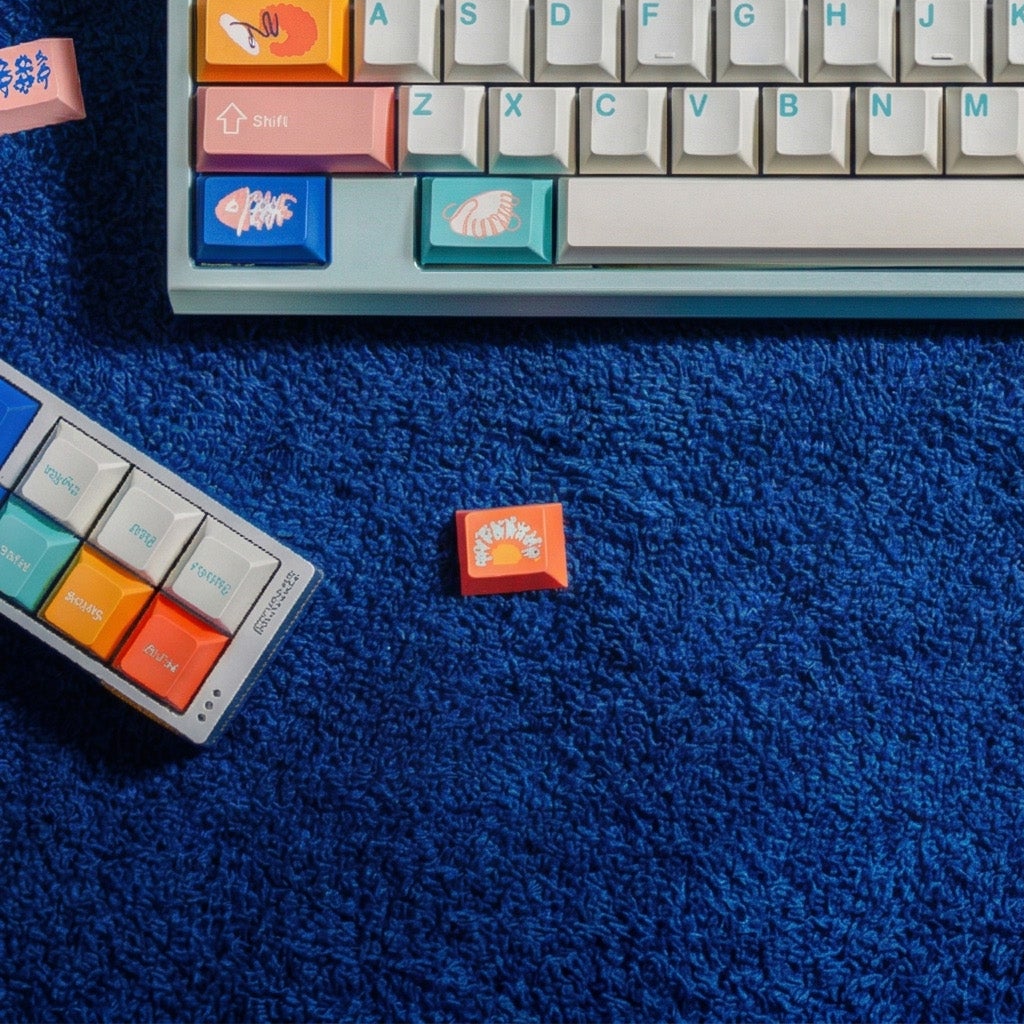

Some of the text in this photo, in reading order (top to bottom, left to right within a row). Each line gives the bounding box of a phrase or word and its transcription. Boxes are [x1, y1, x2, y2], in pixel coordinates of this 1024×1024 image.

[370, 2, 388, 25] A
[460, 2, 477, 25] S
[550, 2, 571, 26] D
[642, 2, 659, 26] F
[734, 3, 755, 27] G
[826, 4, 846, 25] H
[918, 4, 935, 28] J
[413, 93, 432, 116] Z
[504, 93, 522, 117] X
[595, 93, 615, 117] C
[689, 94, 708, 117] V
[780, 94, 798, 117] B
[872, 93, 892, 117] N
[965, 94, 988, 116] M
[252, 114, 289, 129] Shift
